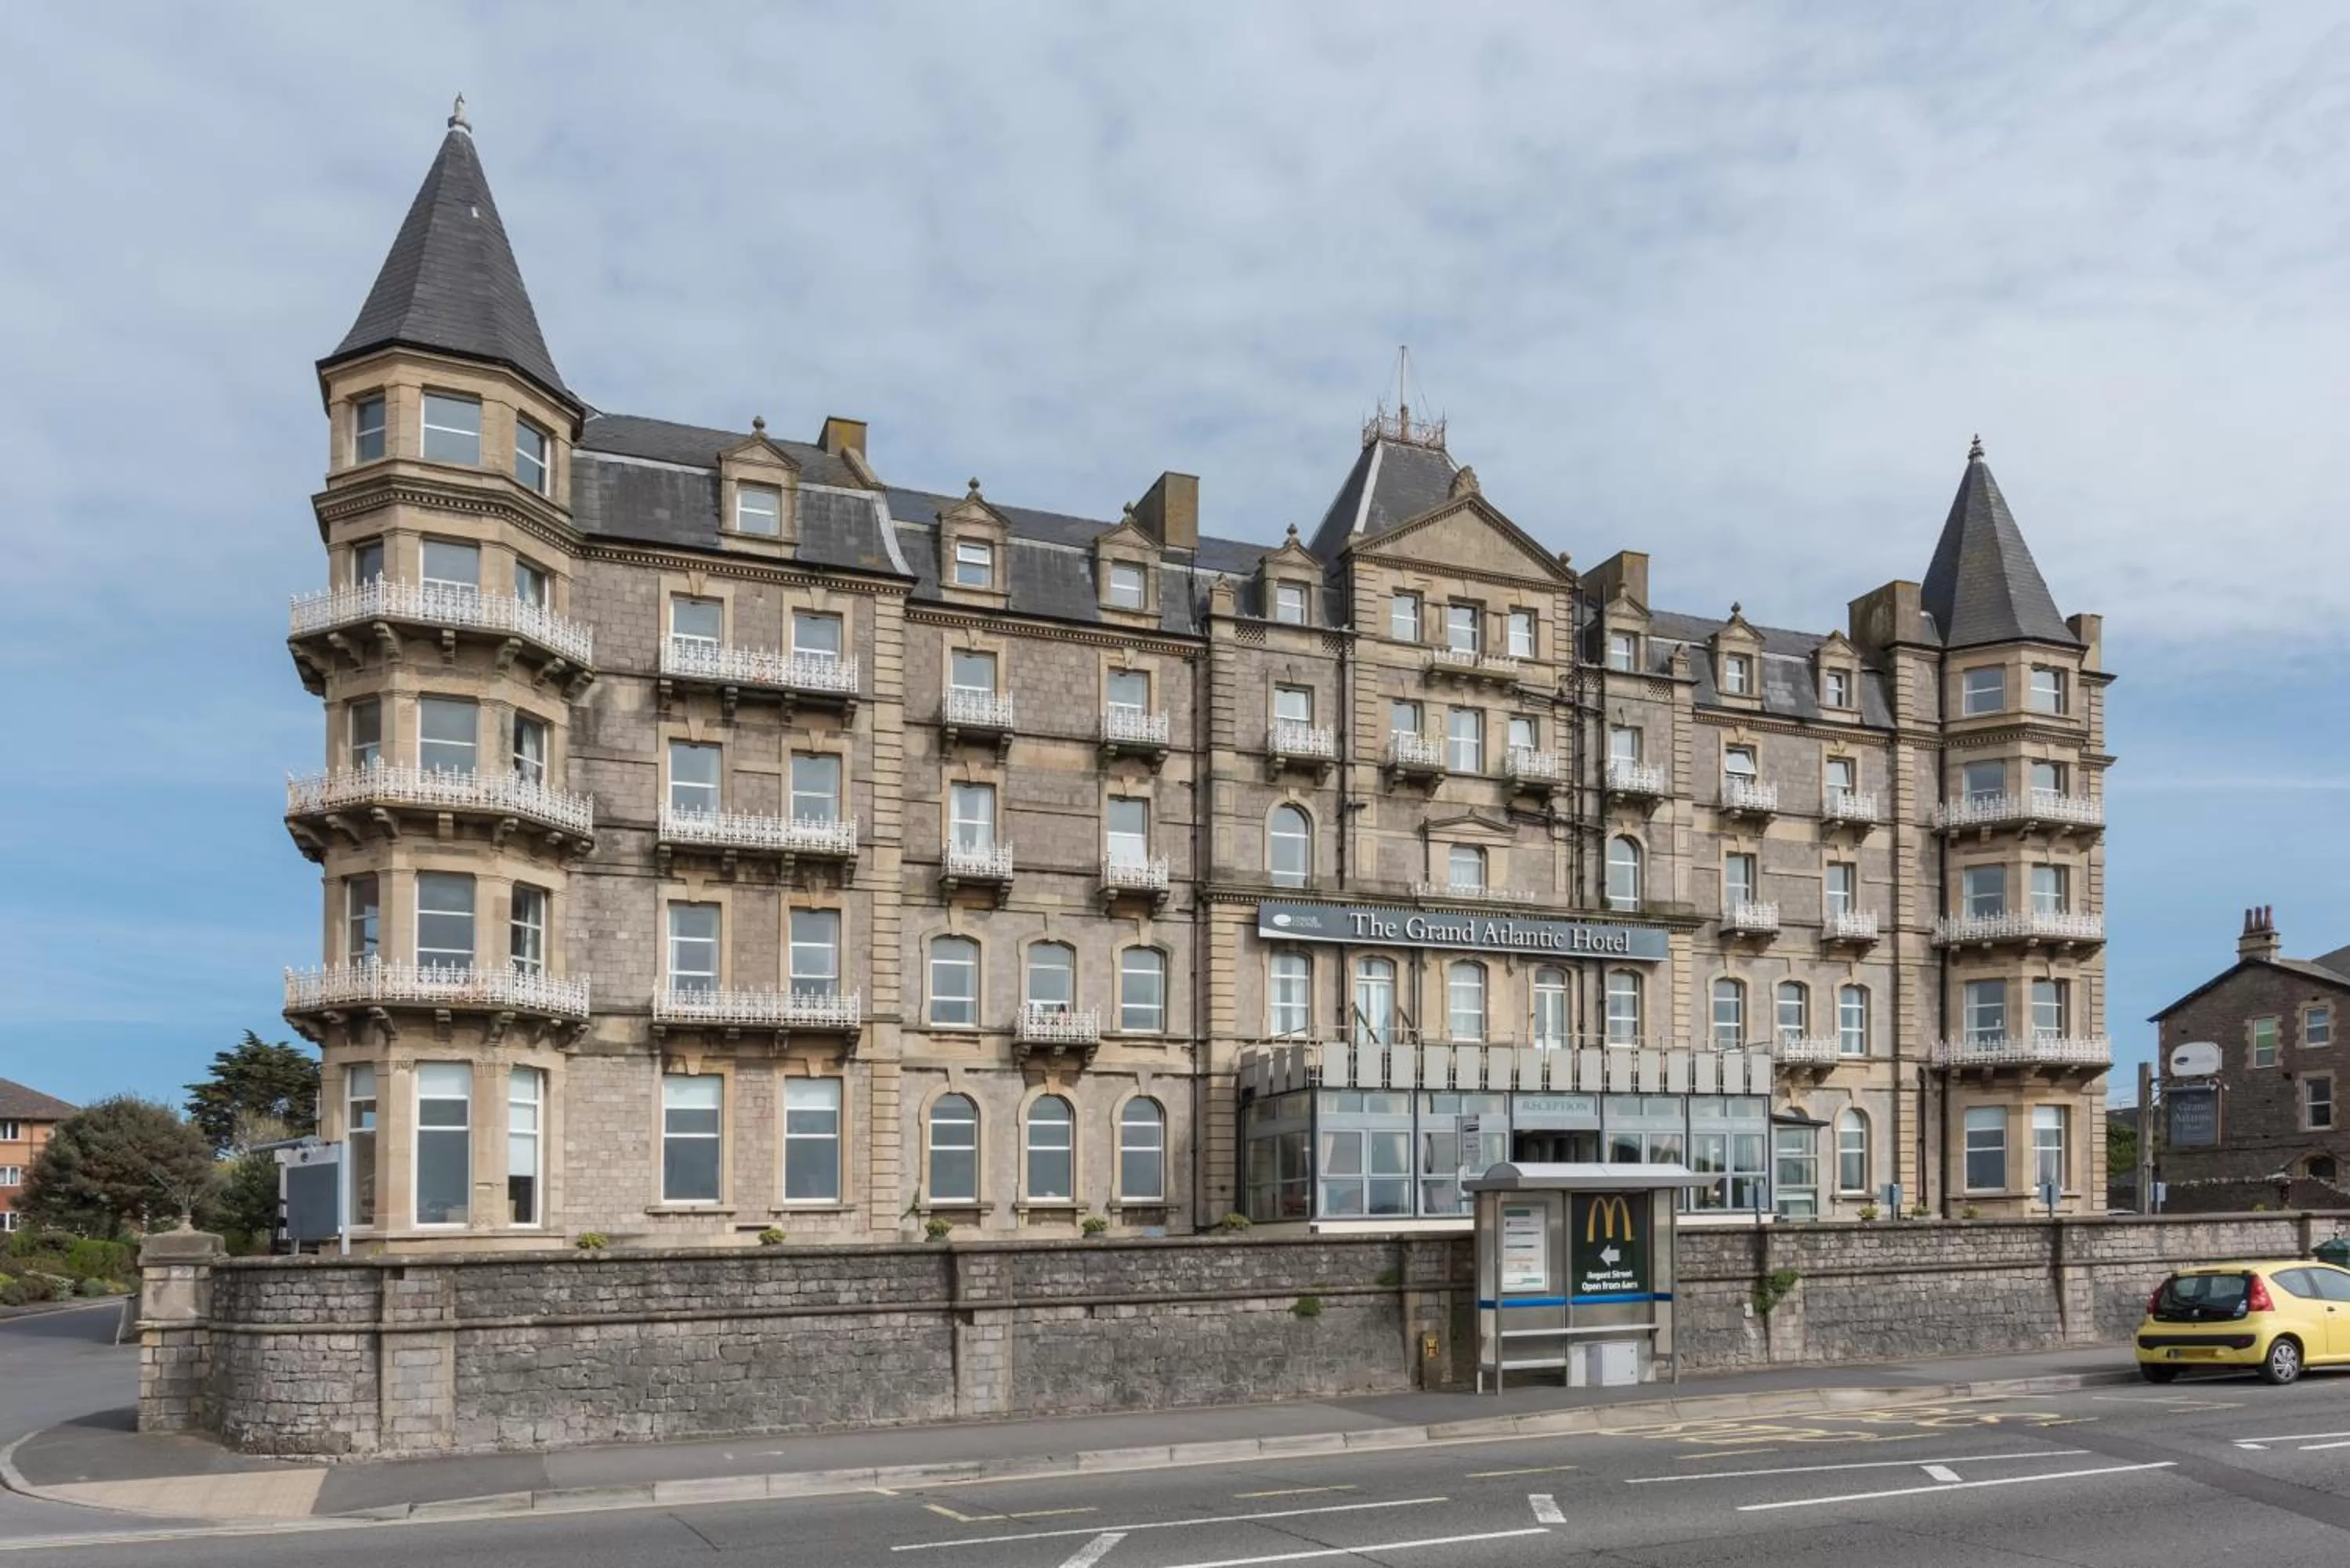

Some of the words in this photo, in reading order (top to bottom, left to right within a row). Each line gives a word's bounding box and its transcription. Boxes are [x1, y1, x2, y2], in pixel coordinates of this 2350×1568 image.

[1349, 912, 1397, 938] The
[1406, 916, 1475, 943] Grand
[1480, 921, 1564, 948] Atlantic
[1571, 927, 1630, 952] Hotel
[1522, 1100, 1589, 1111] RECEPTION
[1611, 1270, 1633, 1279] Street
[1582, 1281, 1602, 1292] Open
[1602, 1281, 1621, 1291] from
